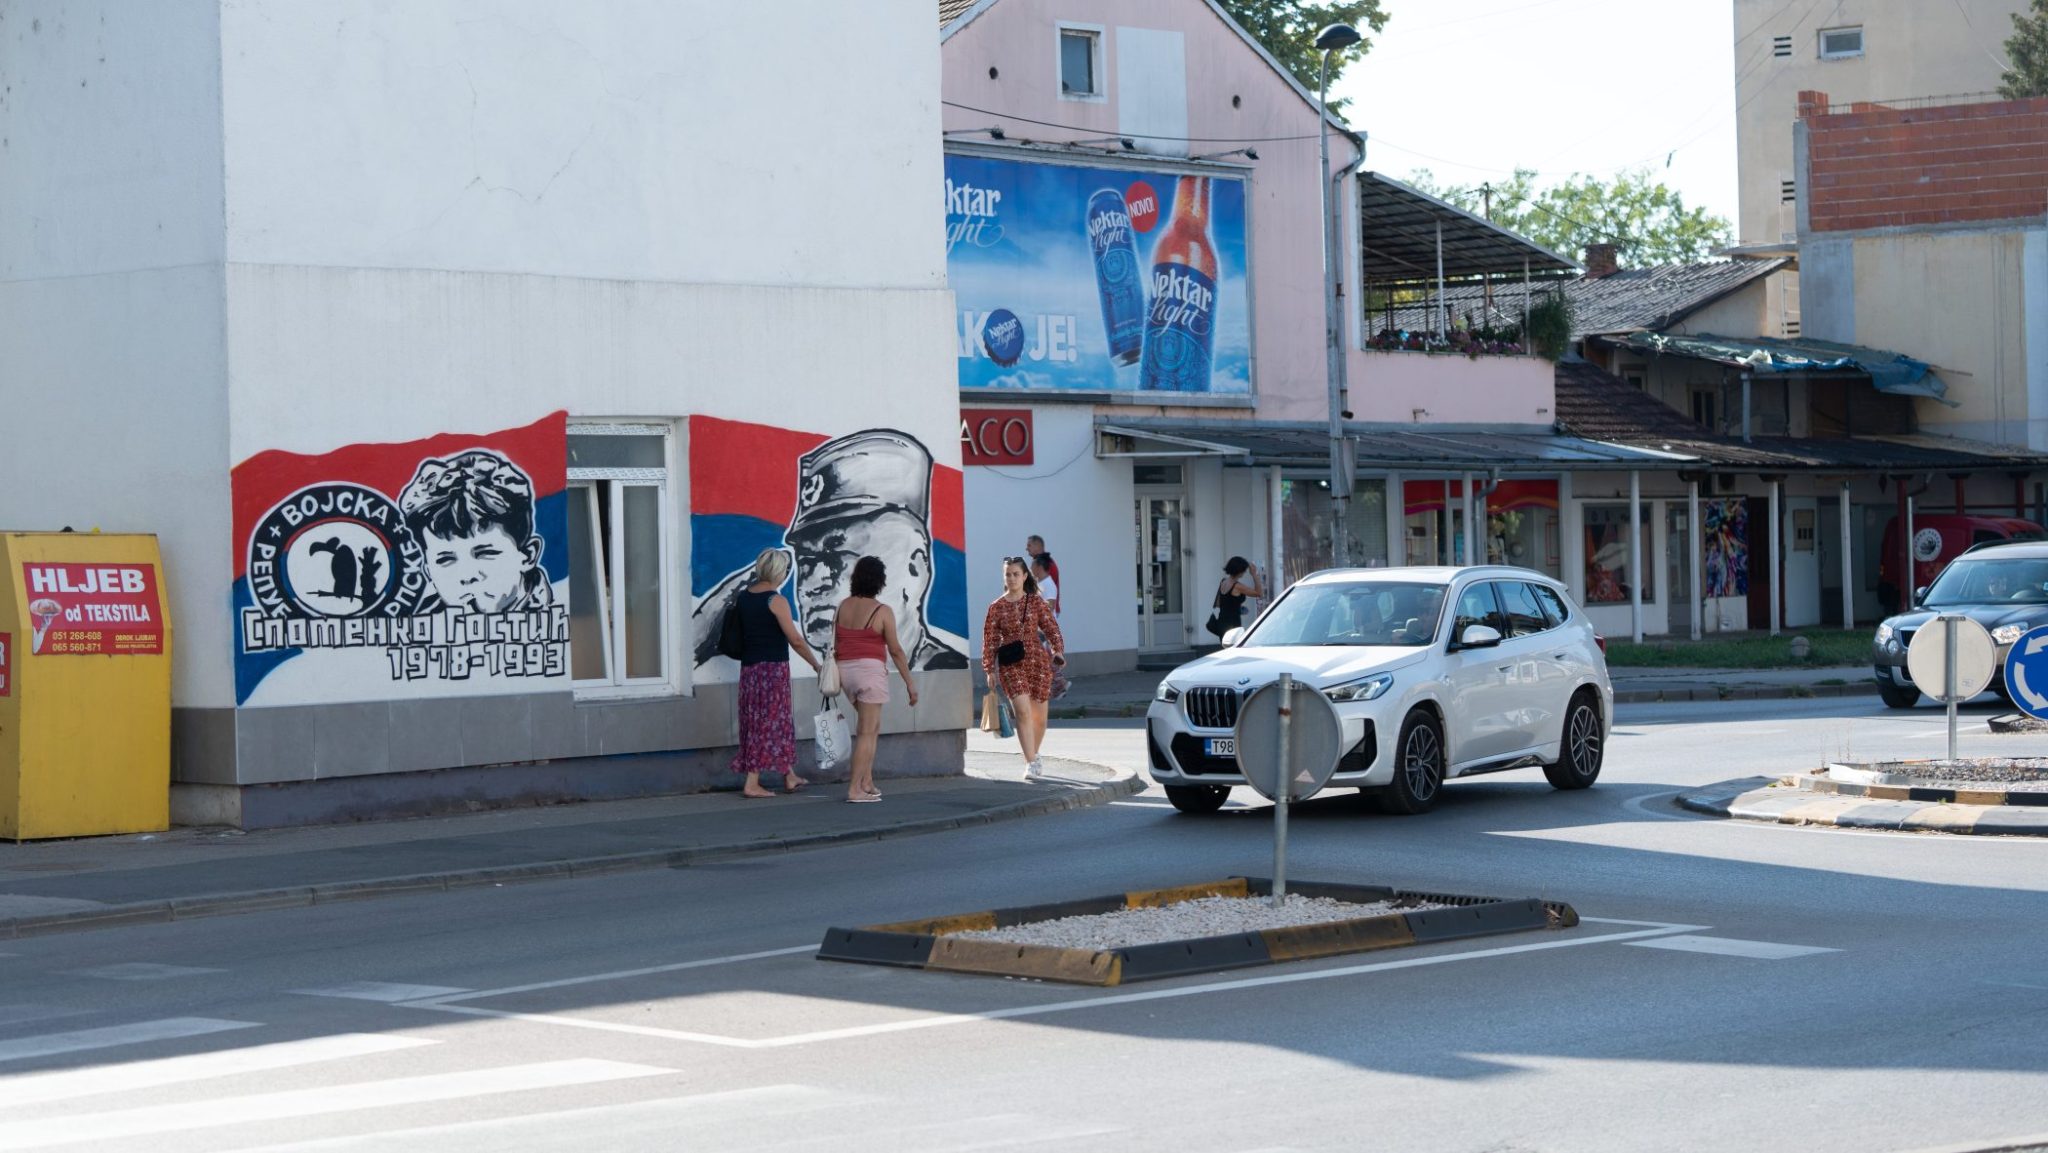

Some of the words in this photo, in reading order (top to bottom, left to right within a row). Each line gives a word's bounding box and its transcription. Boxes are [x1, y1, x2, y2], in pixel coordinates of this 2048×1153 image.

[946, 177, 1001, 217] ktar
[1128, 196, 1155, 218] NOVO!
[946, 207, 1005, 255] ght
[1150, 268, 1212, 312] Nektar
[1029, 314, 1077, 362] JE!
[281, 491, 388, 526] ВОЈСКА
[31, 568, 145, 593] HLJEB
[65, 604, 82, 622] od
[85, 604, 150, 621] TEKSTILA
[52, 632, 67, 640] 051
[52, 643, 67, 652] 065
[387, 642, 566, 681] 1978-1993
